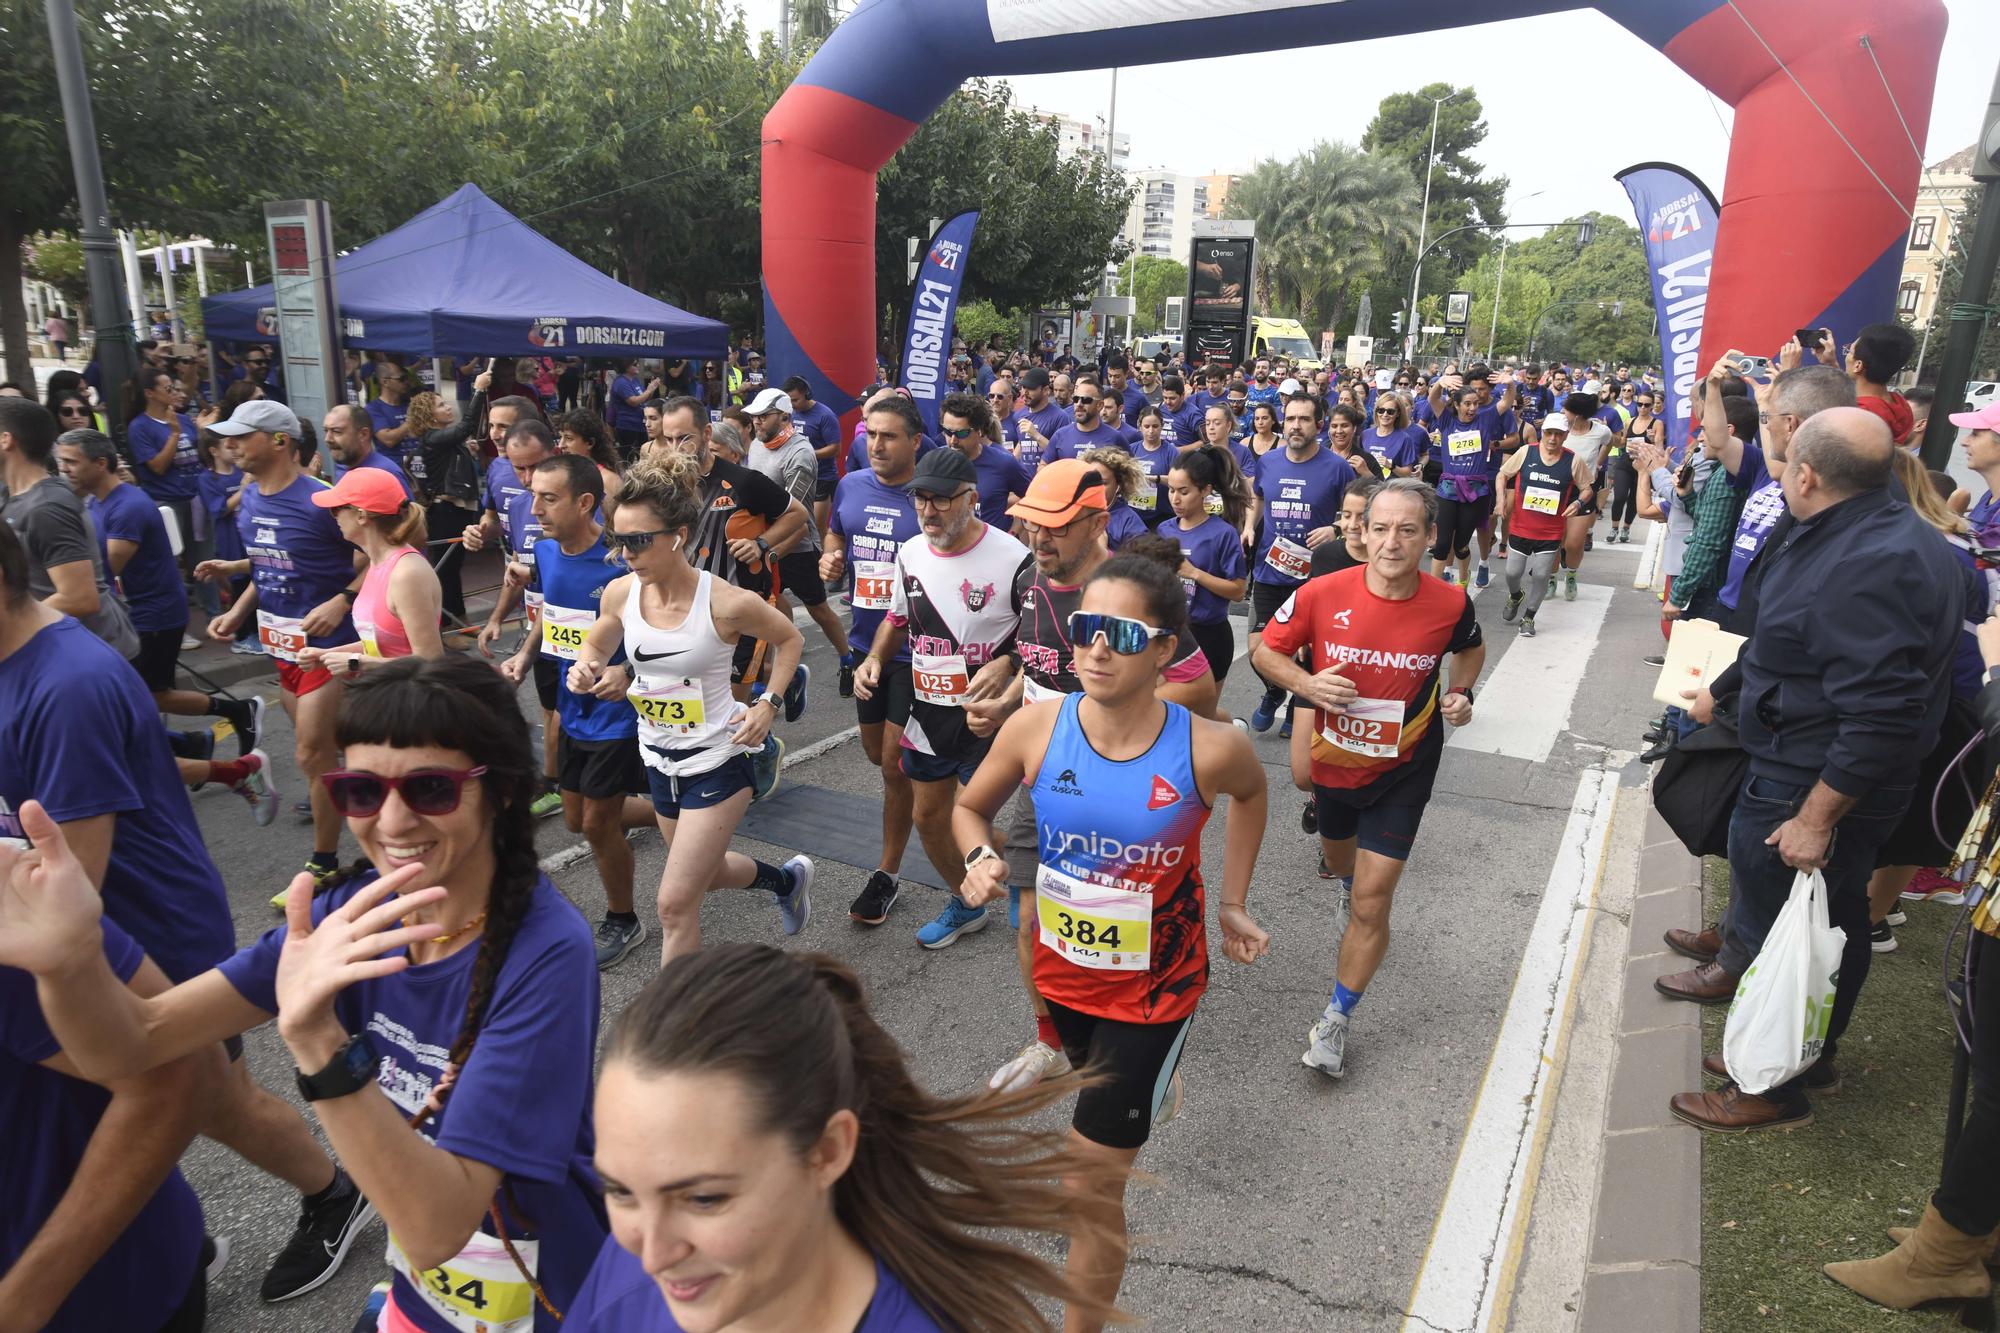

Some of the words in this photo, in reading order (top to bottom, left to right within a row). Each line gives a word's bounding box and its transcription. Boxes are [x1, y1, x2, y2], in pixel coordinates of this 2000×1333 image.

[1659, 191, 1702, 219] DORSAL
[1667, 203, 1702, 241] 21
[940, 249, 958, 270] 21
[543, 325, 565, 347] 21
[575, 326, 665, 347] DORSAL21.COM
[906, 279, 952, 400] DORSAL21
[1456, 439, 1474, 449] 278
[1291, 502, 1303, 511] POR
[1531, 496, 1551, 506] 277
[1289, 510, 1302, 519] POR
[853, 535, 877, 549] CORRO
[879, 538, 895, 552] POR
[853, 546, 874, 559] CORRO
[1278, 552, 1304, 570] 054
[550, 625, 582, 646] 245
[1324, 640, 1438, 672] WERTANIC@S
[920, 674, 953, 691] 025
[641, 699, 685, 719] 273
[1337, 715, 1382, 740] 002
[1060, 858, 1090, 879] CLUB
[1057, 912, 1121, 948] 384
